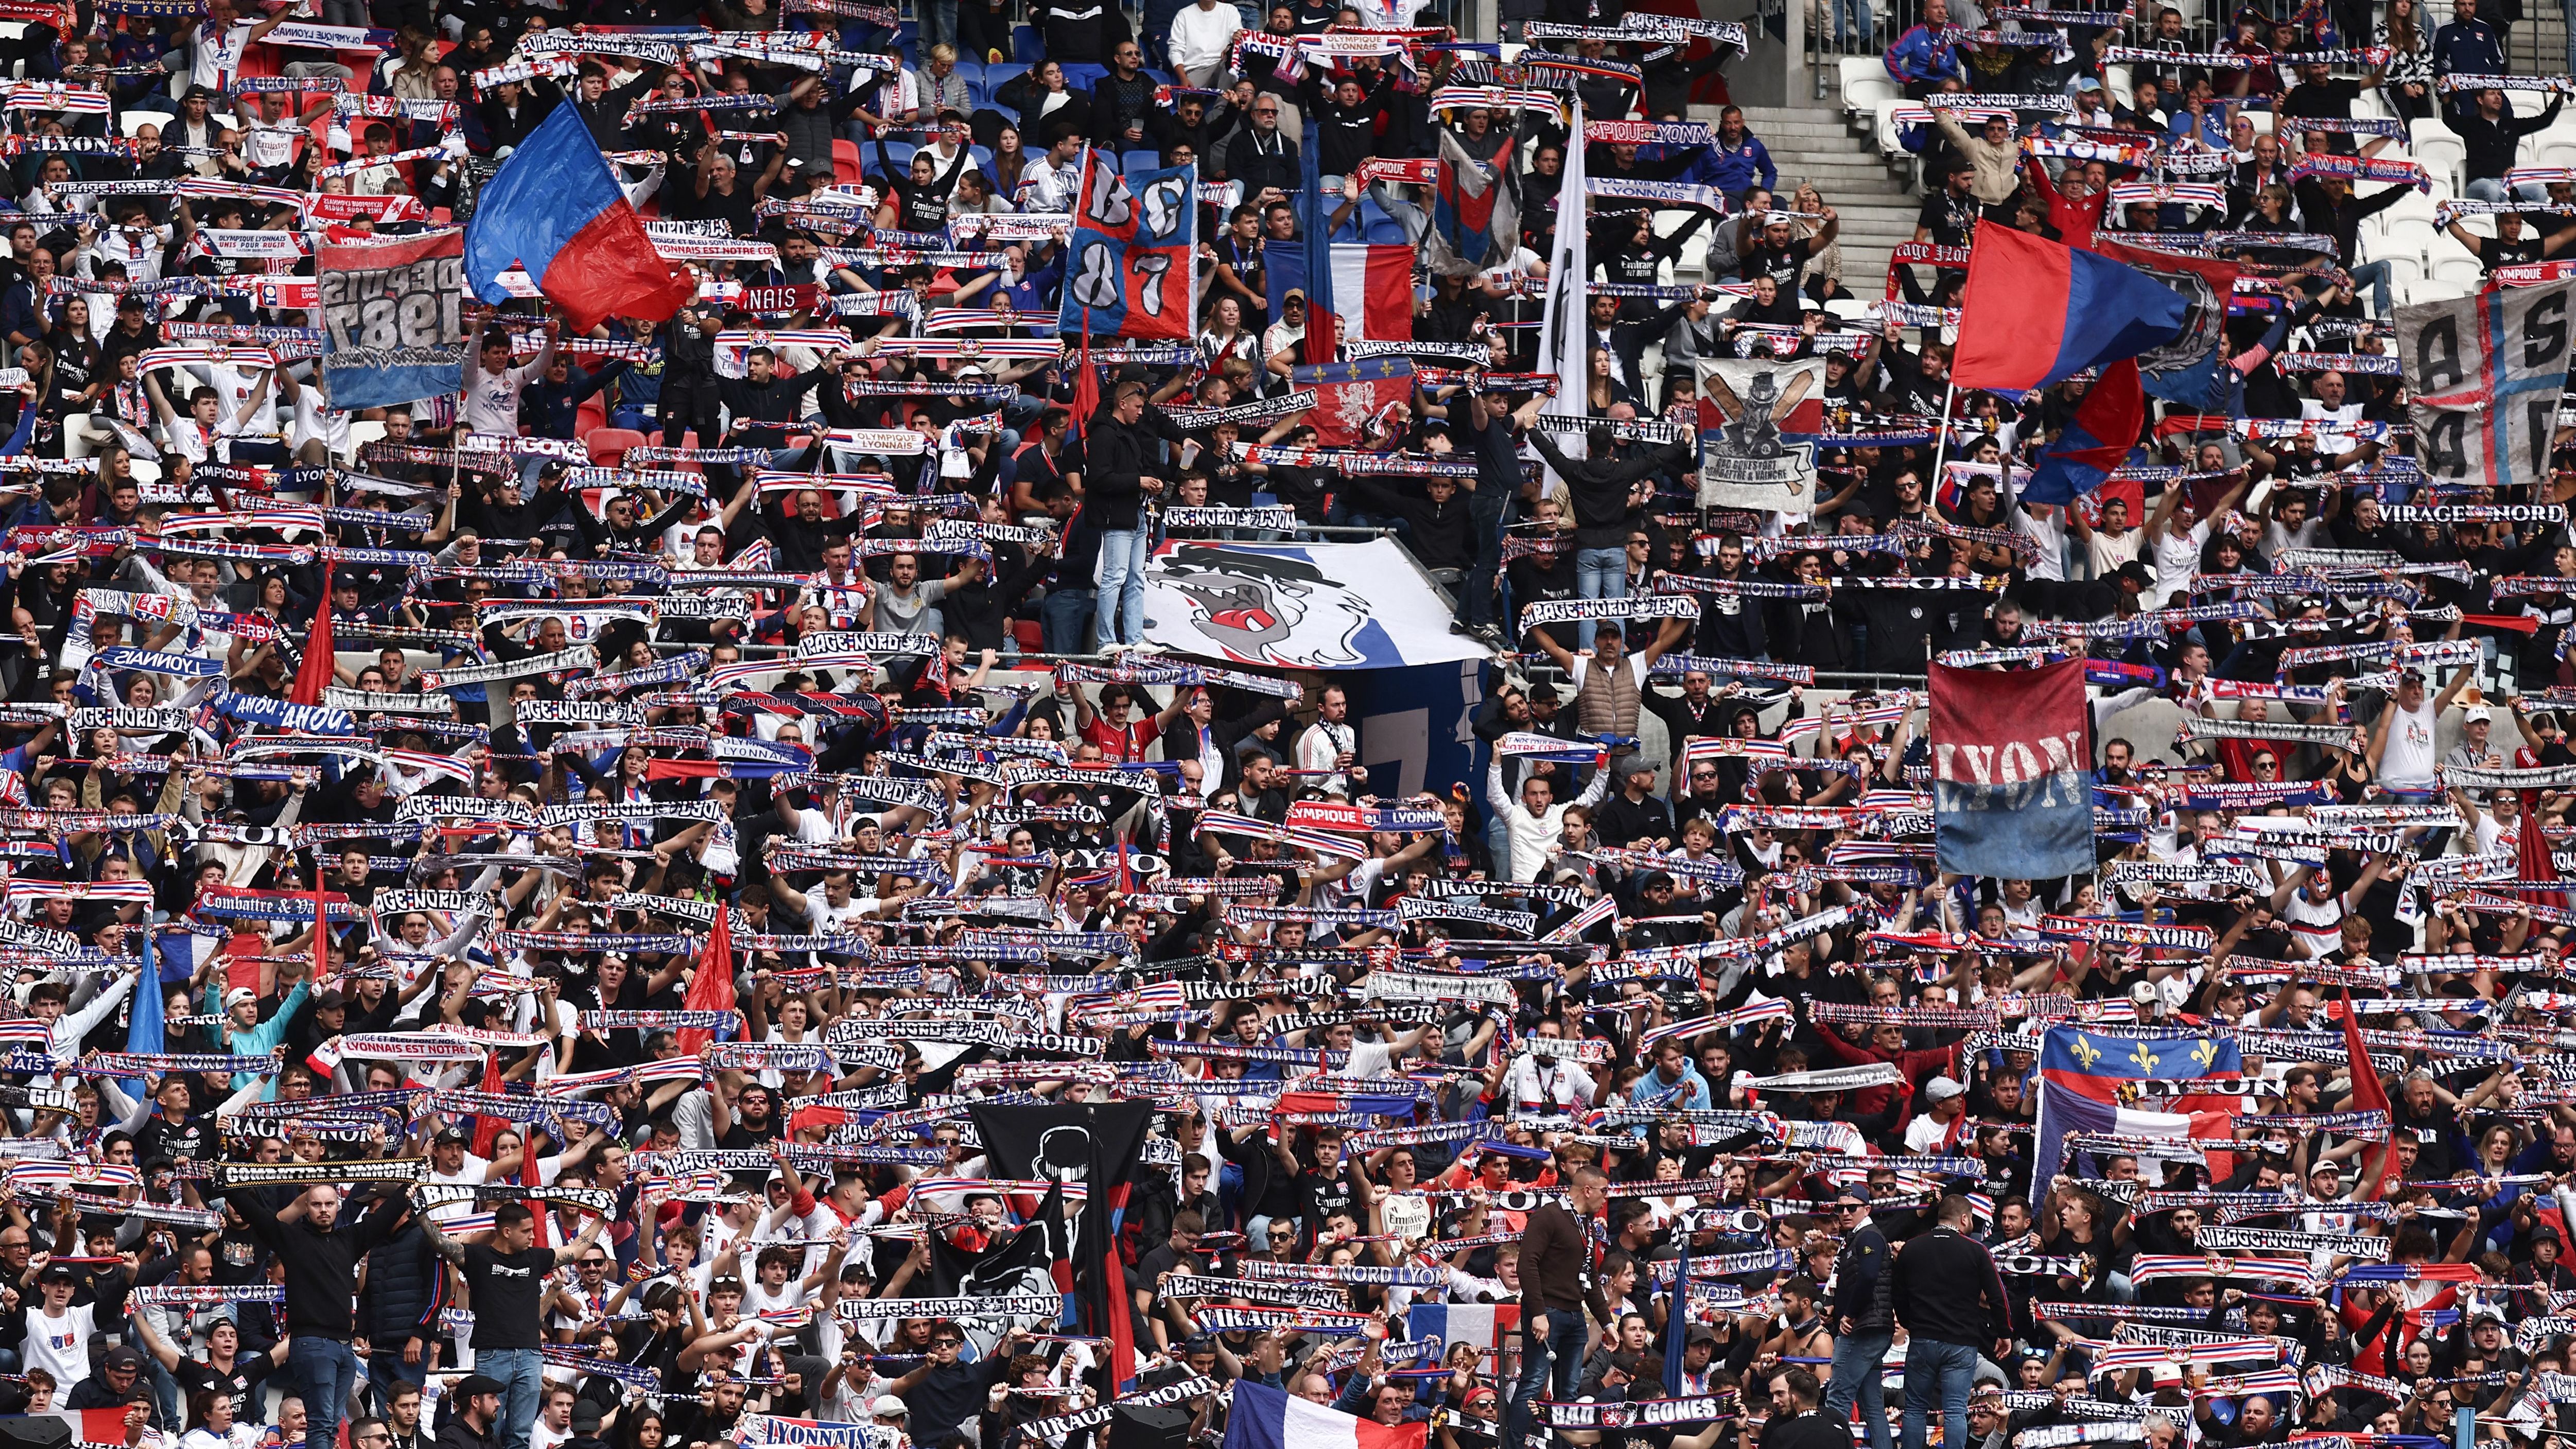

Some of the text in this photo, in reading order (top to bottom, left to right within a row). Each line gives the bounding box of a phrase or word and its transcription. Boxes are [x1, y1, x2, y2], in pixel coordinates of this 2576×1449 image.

[143, 5, 196, 13] PORTO
[1999, 32, 2035, 44] NORD
[693, 98, 731, 108] NORD
[41, 136, 111, 152] LYON
[1605, 187, 1684, 199] LYONNAIS
[912, 201, 945, 213] Emirates
[1621, 260, 1654, 270] Emirates
[53, 276, 105, 292] VIRAGE
[132, 283, 175, 292] NORD
[1134, 254, 1173, 317] 7
[745, 288, 795, 308] NAIS
[169, 323, 297, 340] VIRAGE NORD
[2284, 354, 2400, 374] VIRAGE NORD
[858, 433, 916, 442] OLYMPIQUE
[1345, 458, 1405, 474] VIRAGE
[570, 468, 613, 488] BAD
[2379, 504, 2563, 522] VIRAGE NORD
[159, 537, 223, 555] ALLEZ
[923, 540, 965, 553] NORD
[228, 623, 273, 640] DERBY
[2403, 641, 2478, 666] LYON
[441, 654, 554, 685] VIRAGE NORD
[1688, 657, 1733, 673] NORD
[1134, 669, 1182, 684] NORD
[2190, 724, 2356, 747] VIRAGE NORD LYON
[722, 738, 793, 753] OLYMPIQUE
[724, 747, 793, 763] LYONNAIS
[1935, 730, 2082, 813] LYON
[2187, 782, 2312, 795] OLYMPIQUE LYONNAIS
[2220, 798, 2249, 808] APOEL
[106, 814, 151, 828] NORD
[773, 853, 910, 874] VIRAGE NORD
[1668, 858, 1717, 878] NORD
[1854, 867, 1904, 883] NORD
[1227, 907, 1284, 925] VIRAGE
[1313, 908, 1362, 924] NORD
[497, 934, 686, 954] VIRAGE NORD LYON
[1037, 928, 1087, 946] NORD
[1046, 976, 1093, 992] NORD
[1415, 976, 1461, 996] NORD
[1466, 978, 1509, 999] LYON
[2028, 995, 2074, 1016] NORD
[1266, 1007, 1351, 1034] VIRAGE
[473, 1028, 491, 1037] EST
[493, 1031, 528, 1042] NOTRE
[2111, 1025, 2160, 1040] NORD
[346, 1043, 466, 1054] LYONNAIS EST NOTRE
[1020, 1034, 1101, 1055] NORD
[1530, 1040, 1579, 1060] LYON
[1362, 1080, 1415, 1096] NORD
[159, 1136, 201, 1149] Emirates
[778, 1140, 946, 1167] VIRAGE NORD LYON
[1884, 1155, 1939, 1171] NORD
[226, 1164, 329, 1183] COMBATTRE
[345, 1162, 415, 1178] VAINCRE
[419, 1186, 611, 1206] BAD GONES
[1771, 1200, 1813, 1216] BAD
[1389, 1211, 1427, 1225] Emirates
[1725, 1252, 1778, 1271] NORD
[1245, 1262, 1309, 1280] VIRAGE
[1339, 1267, 1390, 1284] NORD
[222, 1284, 278, 1301] NORD
[1003, 1296, 1058, 1317] LYON
[2039, 1303, 2182, 1320] VIRAGE NORD
[1550, 1397, 1717, 1426] BAD GONES
[768, 1419, 870, 1445] LYONNAIS
[2084, 1422, 2140, 1441] NORD
